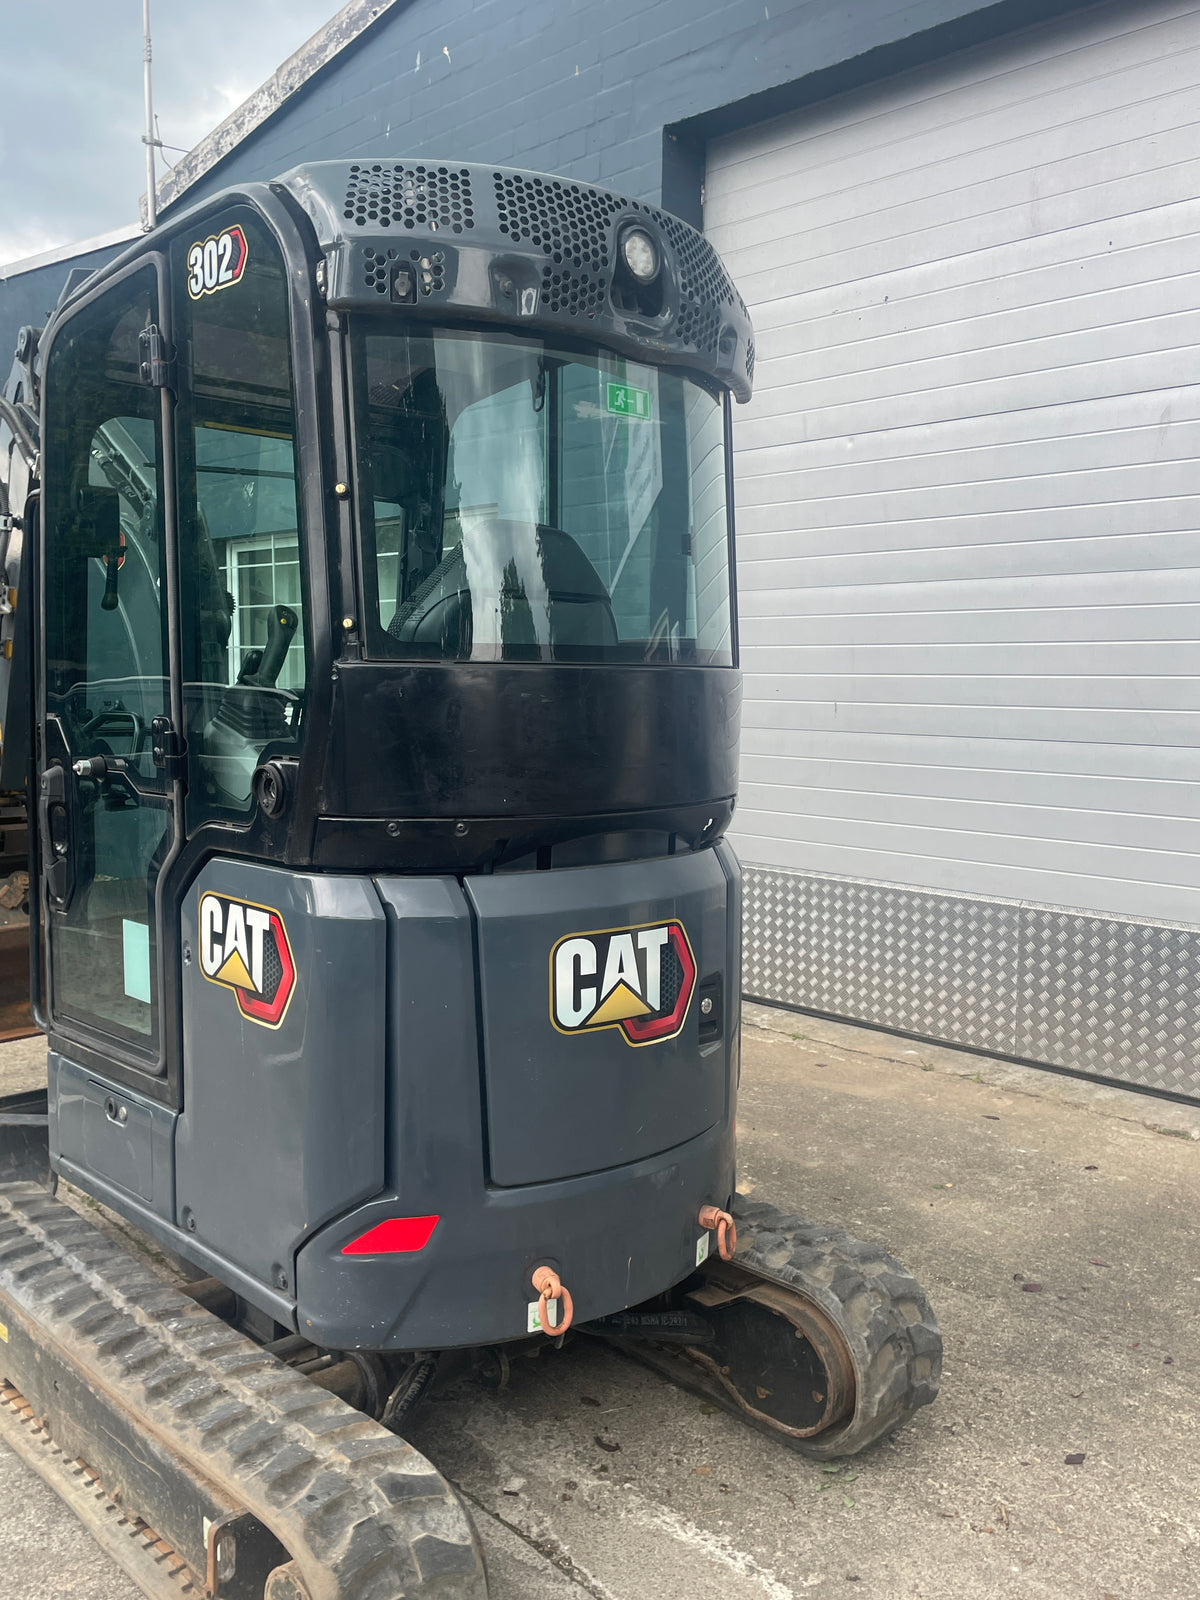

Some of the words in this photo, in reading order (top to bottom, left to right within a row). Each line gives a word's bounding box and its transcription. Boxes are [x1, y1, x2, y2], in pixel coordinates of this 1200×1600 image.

[190, 234, 232, 293] 302
[201, 896, 269, 993] CAT
[556, 927, 668, 1027] CAT
